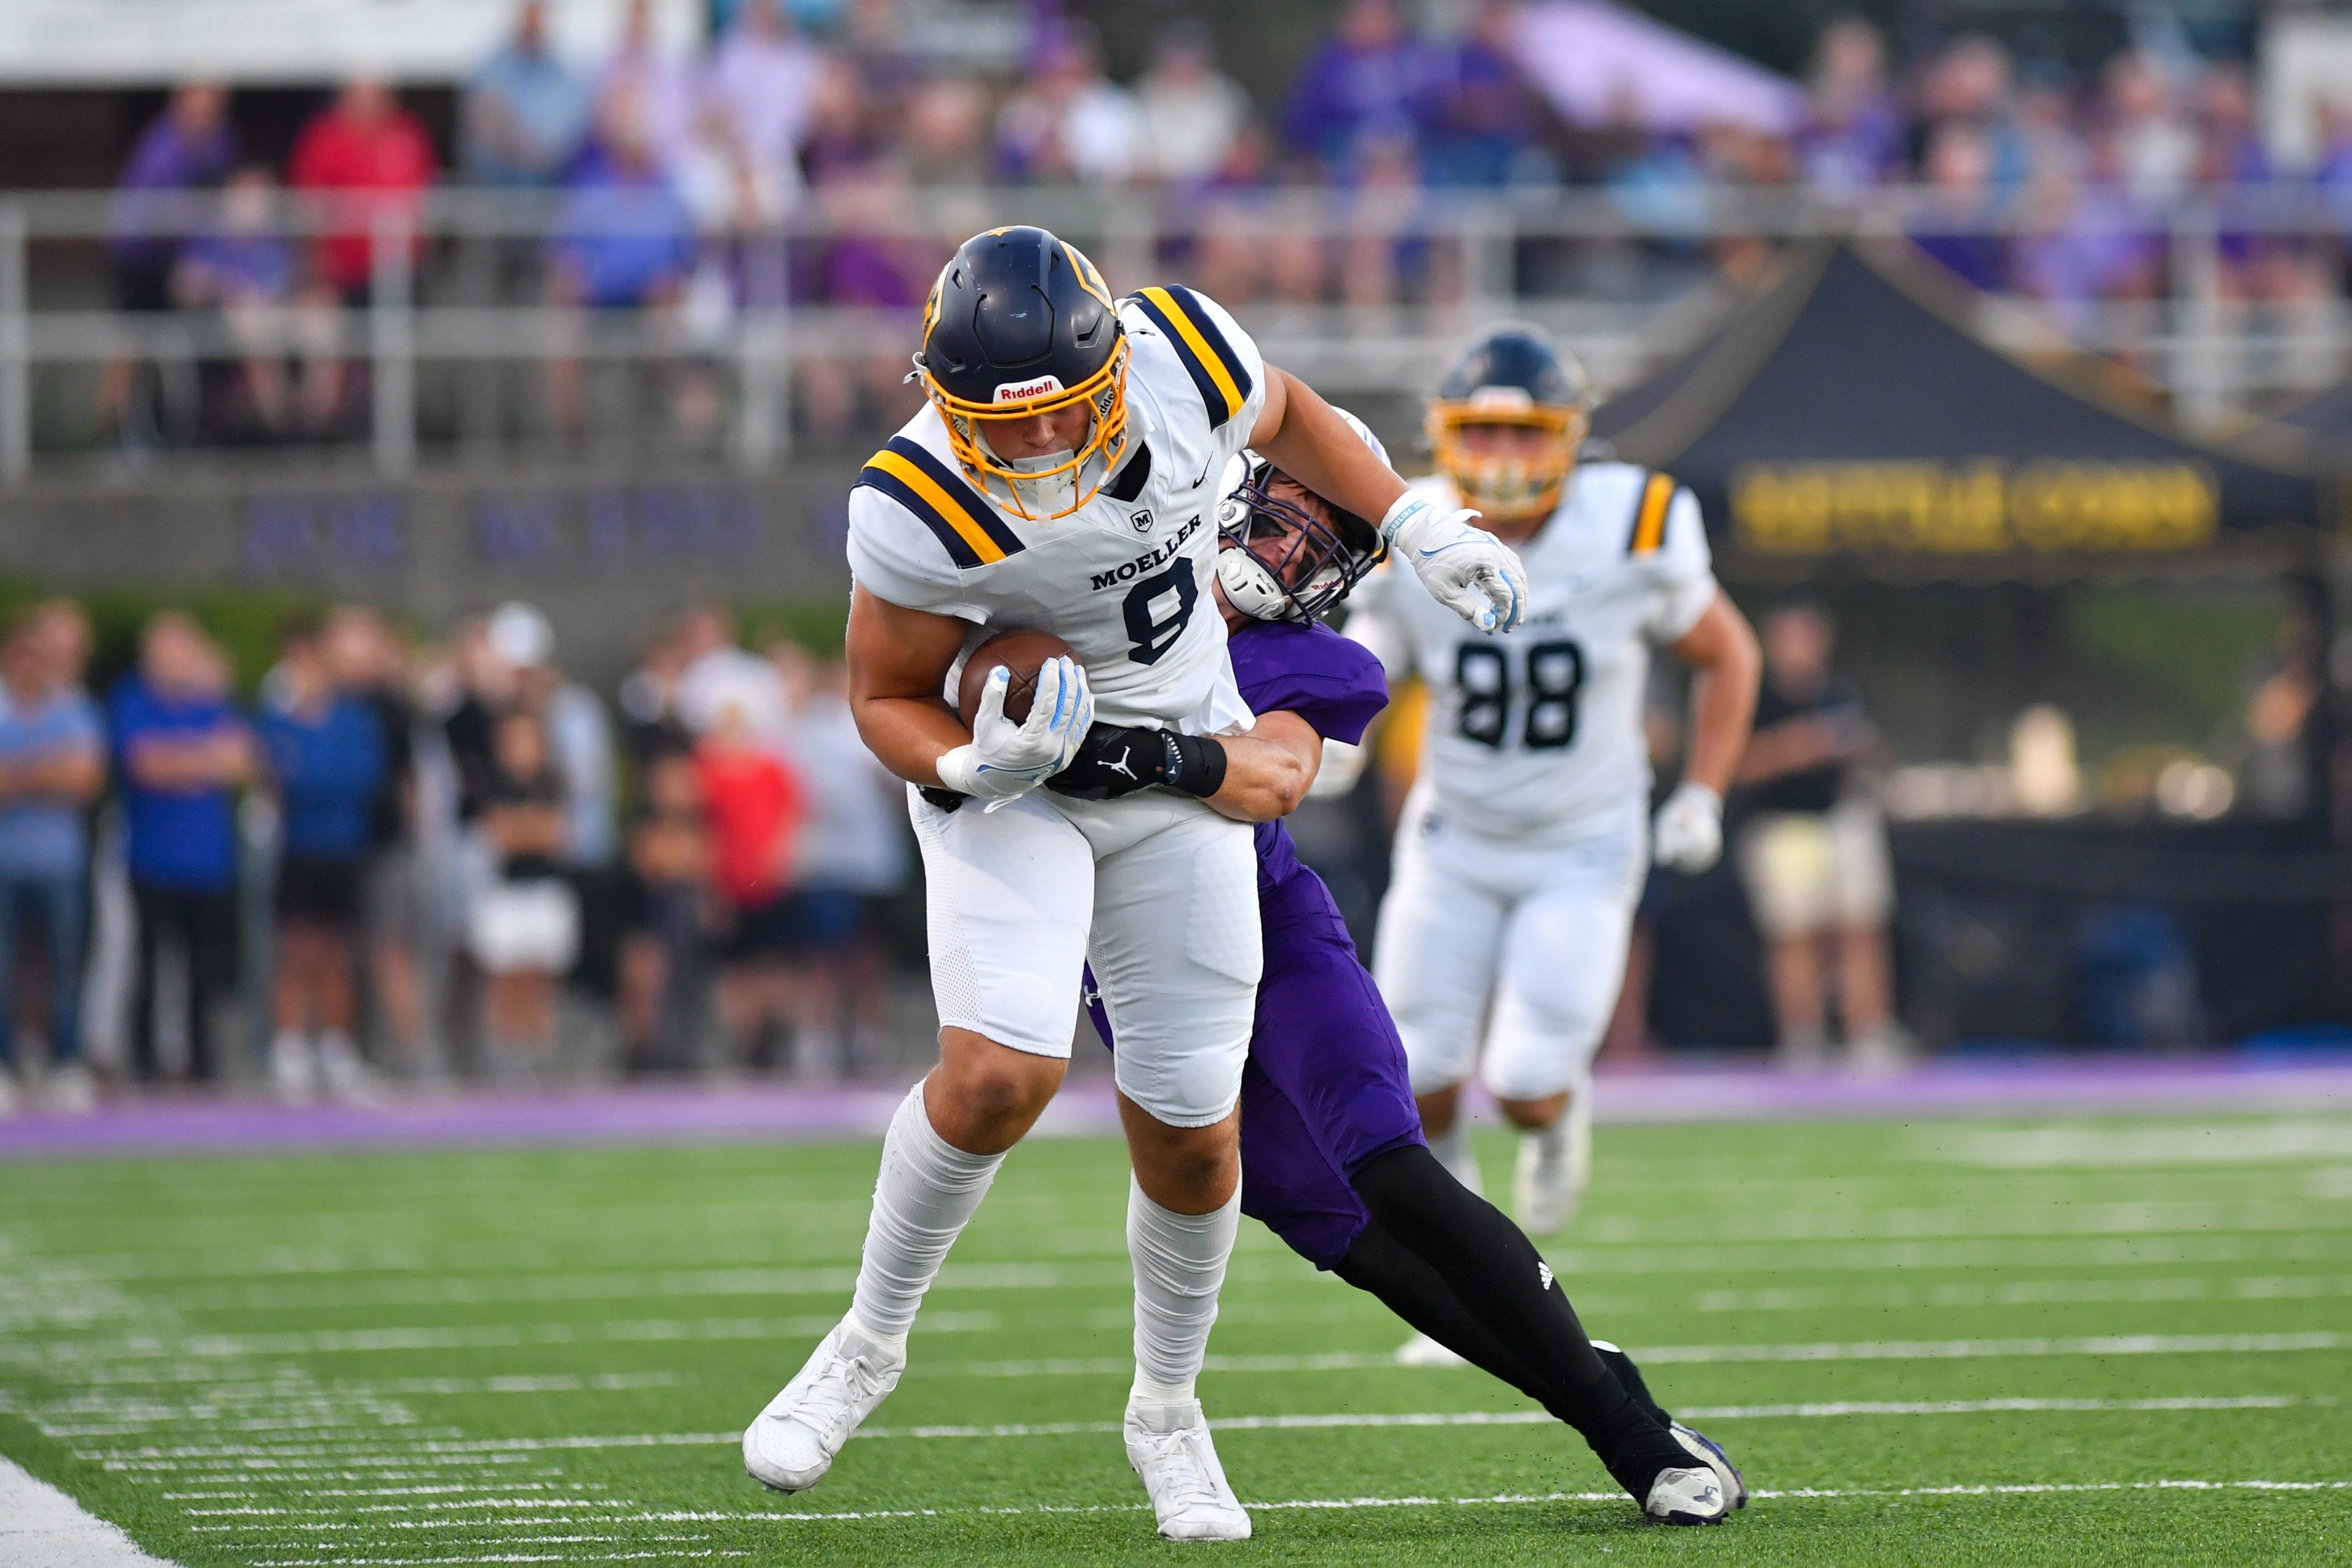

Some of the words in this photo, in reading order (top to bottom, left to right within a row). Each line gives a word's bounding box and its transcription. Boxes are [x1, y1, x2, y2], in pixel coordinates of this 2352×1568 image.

[1001, 380, 1053, 400] Riddell
[1135, 513, 1150, 527] M
[1387, 508, 1413, 536] CAROLINA
[1091, 513, 1201, 590] MOELLER
[1122, 556, 1198, 666] 9
[1458, 643, 1583, 748] 88
